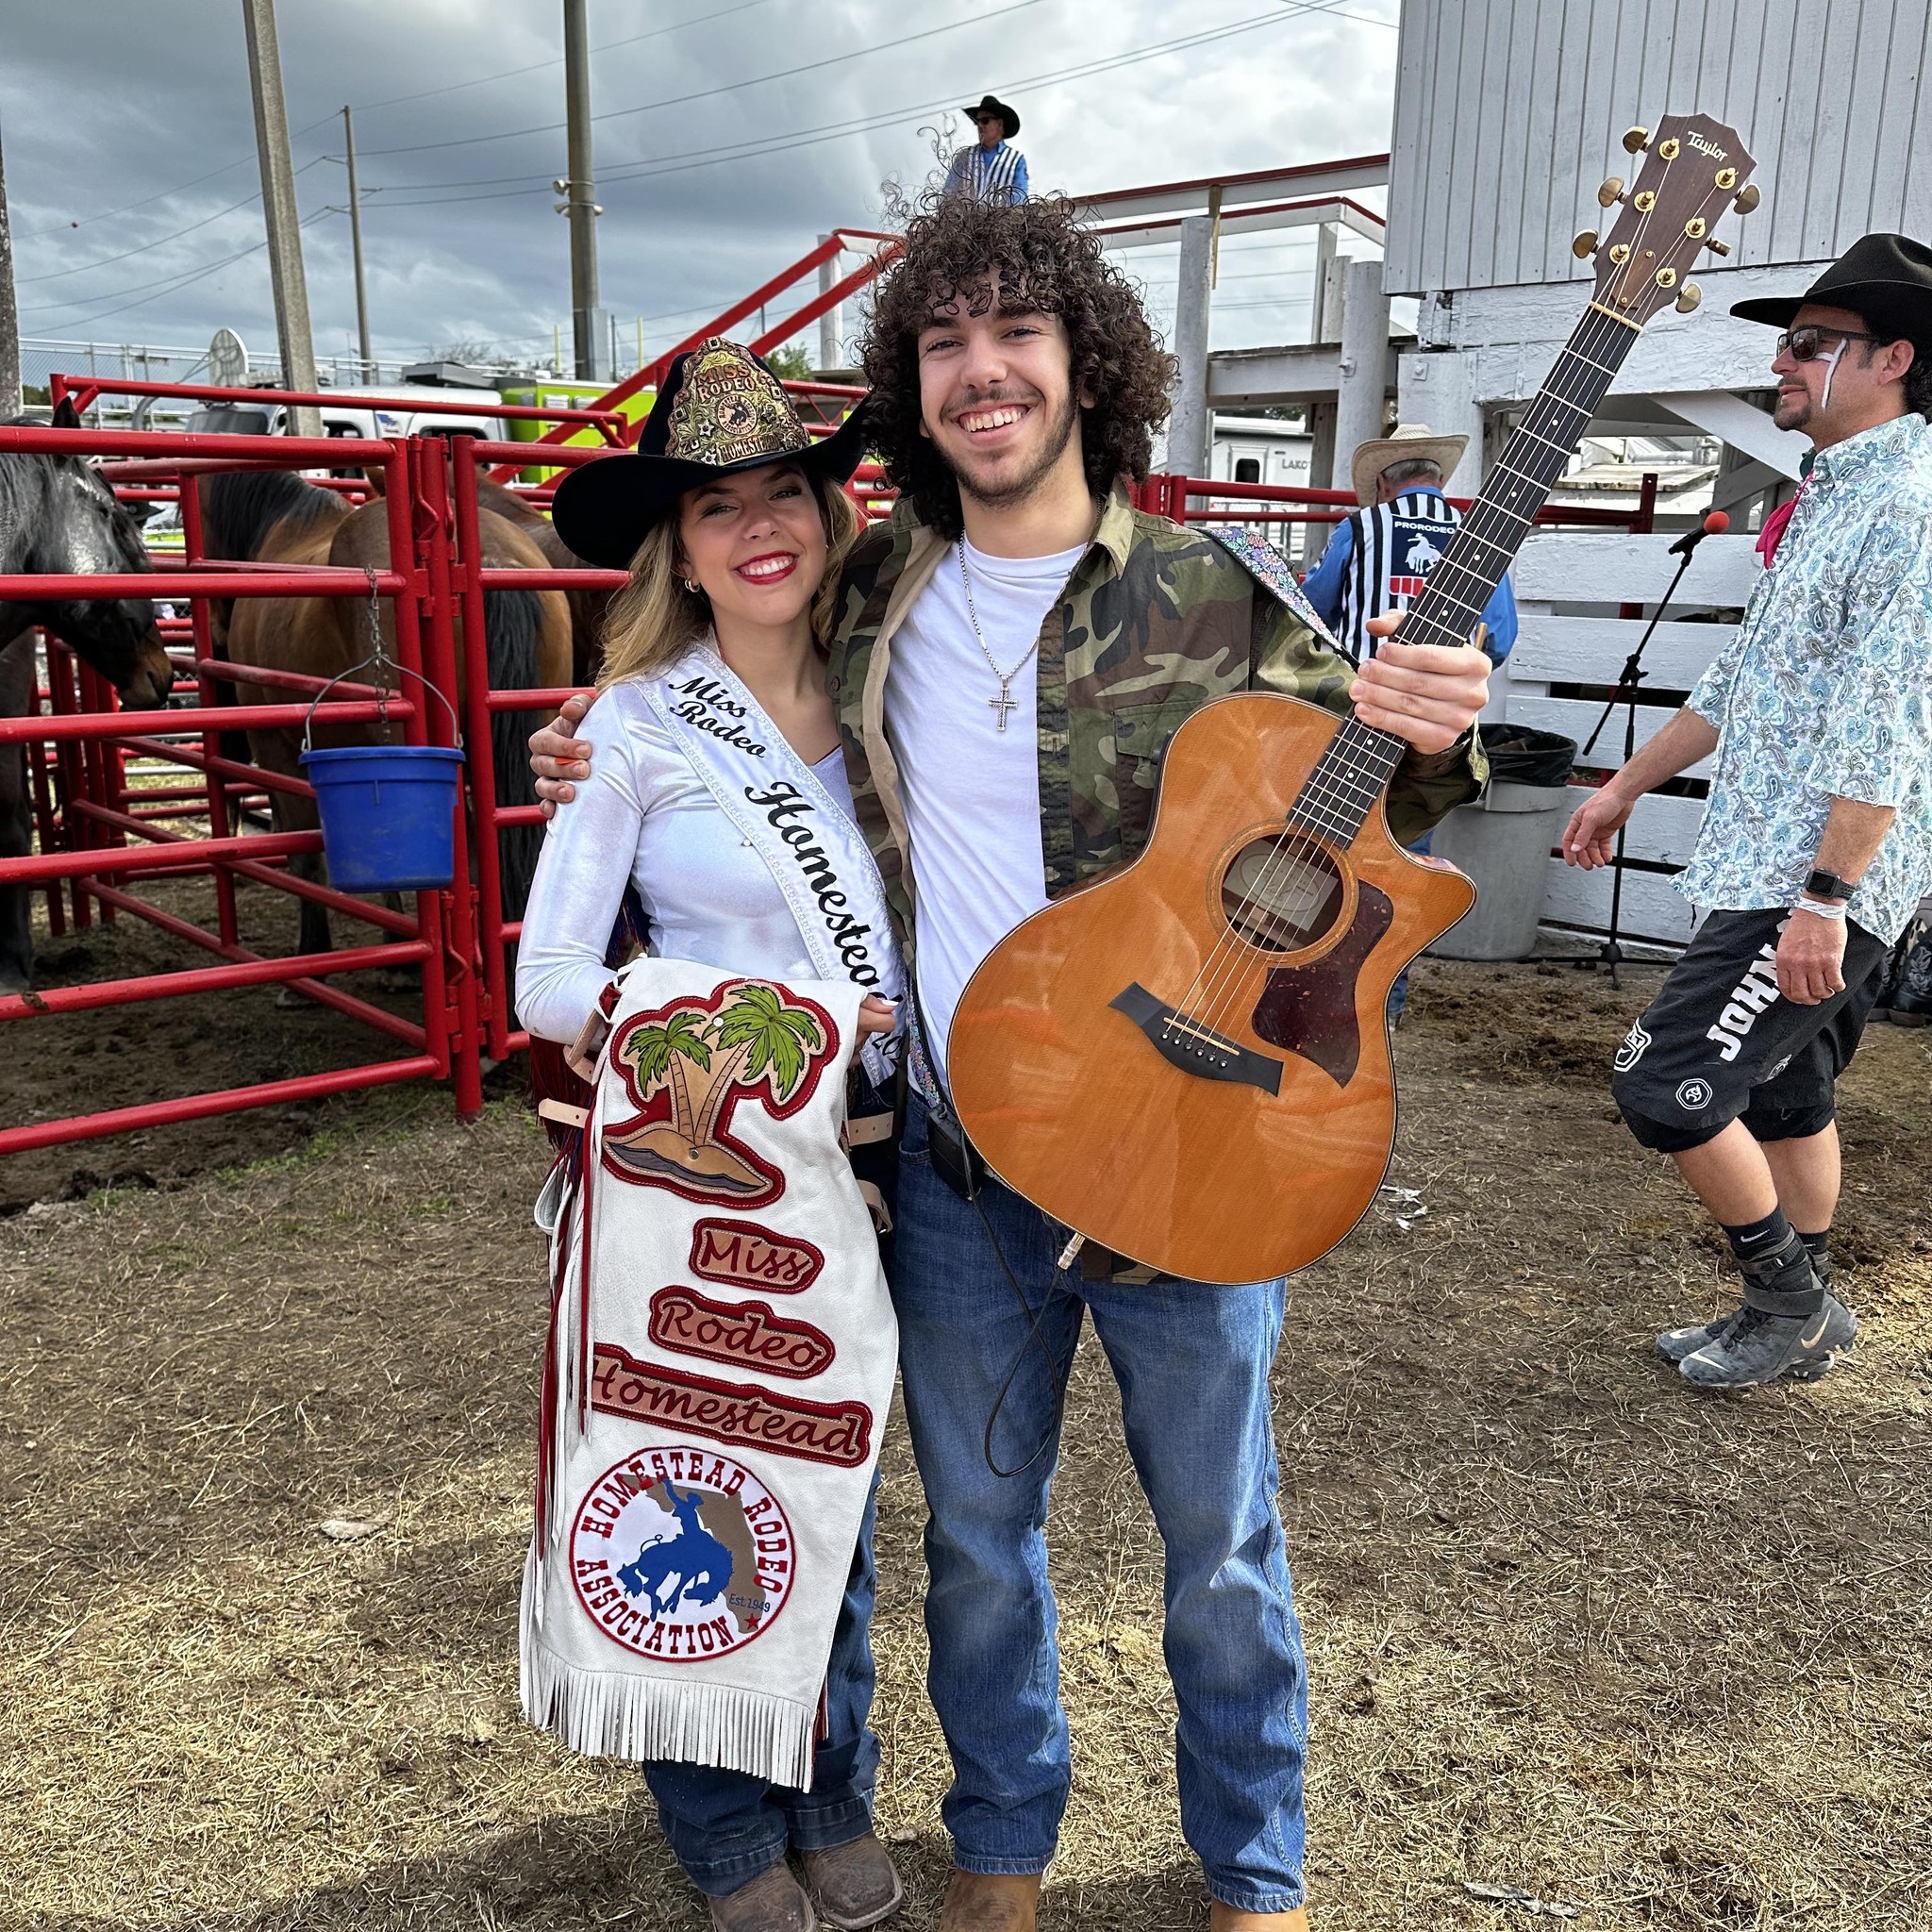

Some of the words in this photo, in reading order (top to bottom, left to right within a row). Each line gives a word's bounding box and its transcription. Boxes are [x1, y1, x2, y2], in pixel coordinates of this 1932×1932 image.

[1687, 130, 1728, 162] Taylor
[694, 364, 751, 387] MISS
[696, 376, 757, 403] RODEO
[1281, 458, 1312, 470] LAKO
[1393, 521, 1456, 535] PRORODEO
[668, 675, 747, 719] Miss
[669, 700, 767, 759] Rodeo
[743, 781, 904, 1003] Homestea
[701, 1230, 813, 1280] Miss
[660, 1301, 824, 1368] Rodeo
[592, 1359, 860, 1456] Homestead
[580, 1452, 746, 1540] HOMESTEAD
[742, 1496, 789, 1594] RODEO
[576, 1558, 735, 1655] ASSOCIATION
[747, 1598, 772, 1613] 1949
